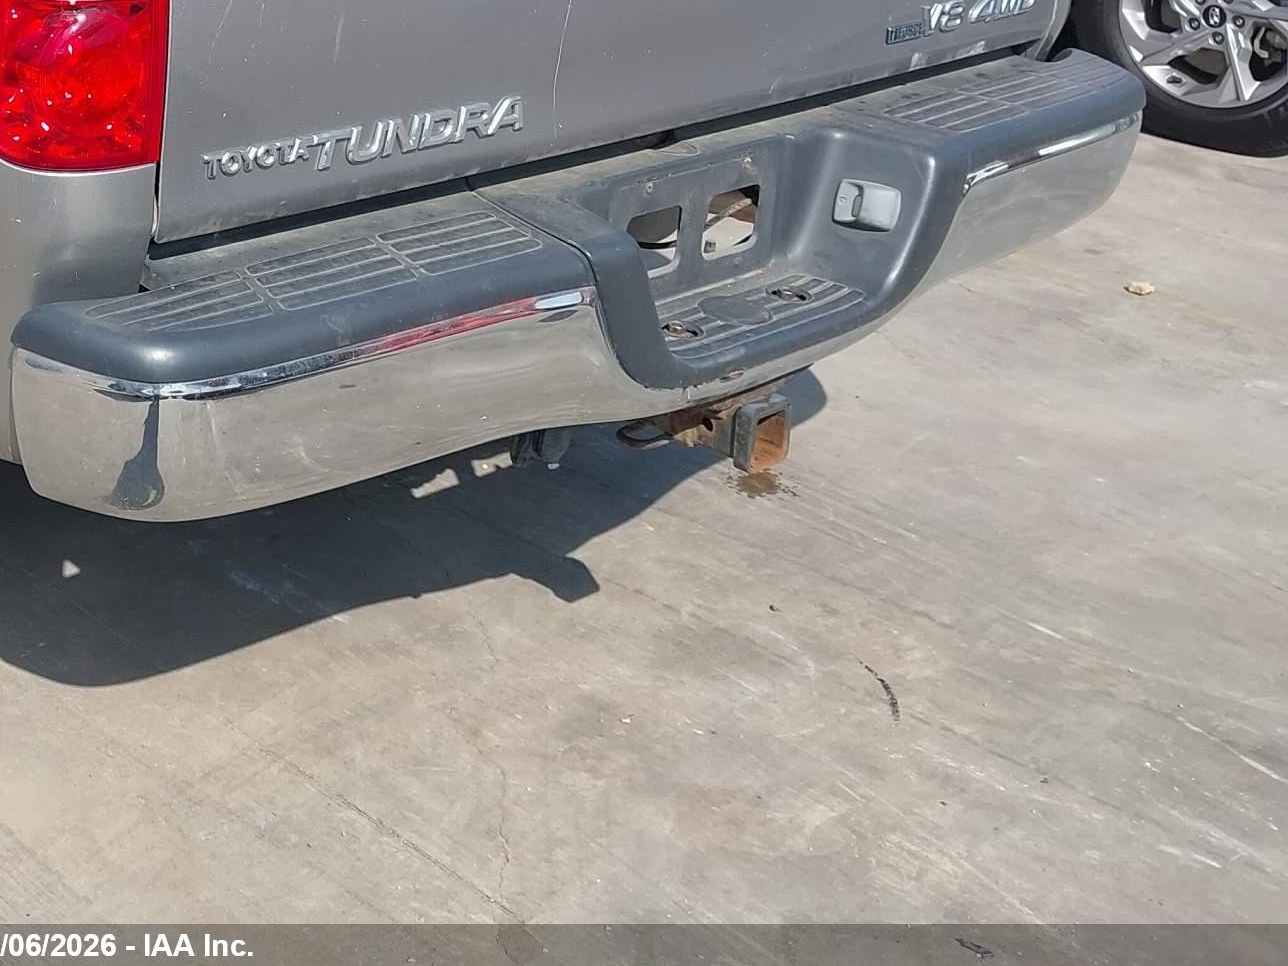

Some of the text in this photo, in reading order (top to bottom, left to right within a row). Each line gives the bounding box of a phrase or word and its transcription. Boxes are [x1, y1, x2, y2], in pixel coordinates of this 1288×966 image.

[922, 0, 965, 36] V8
[201, 93, 525, 180] TOYOTA TUNDRA
